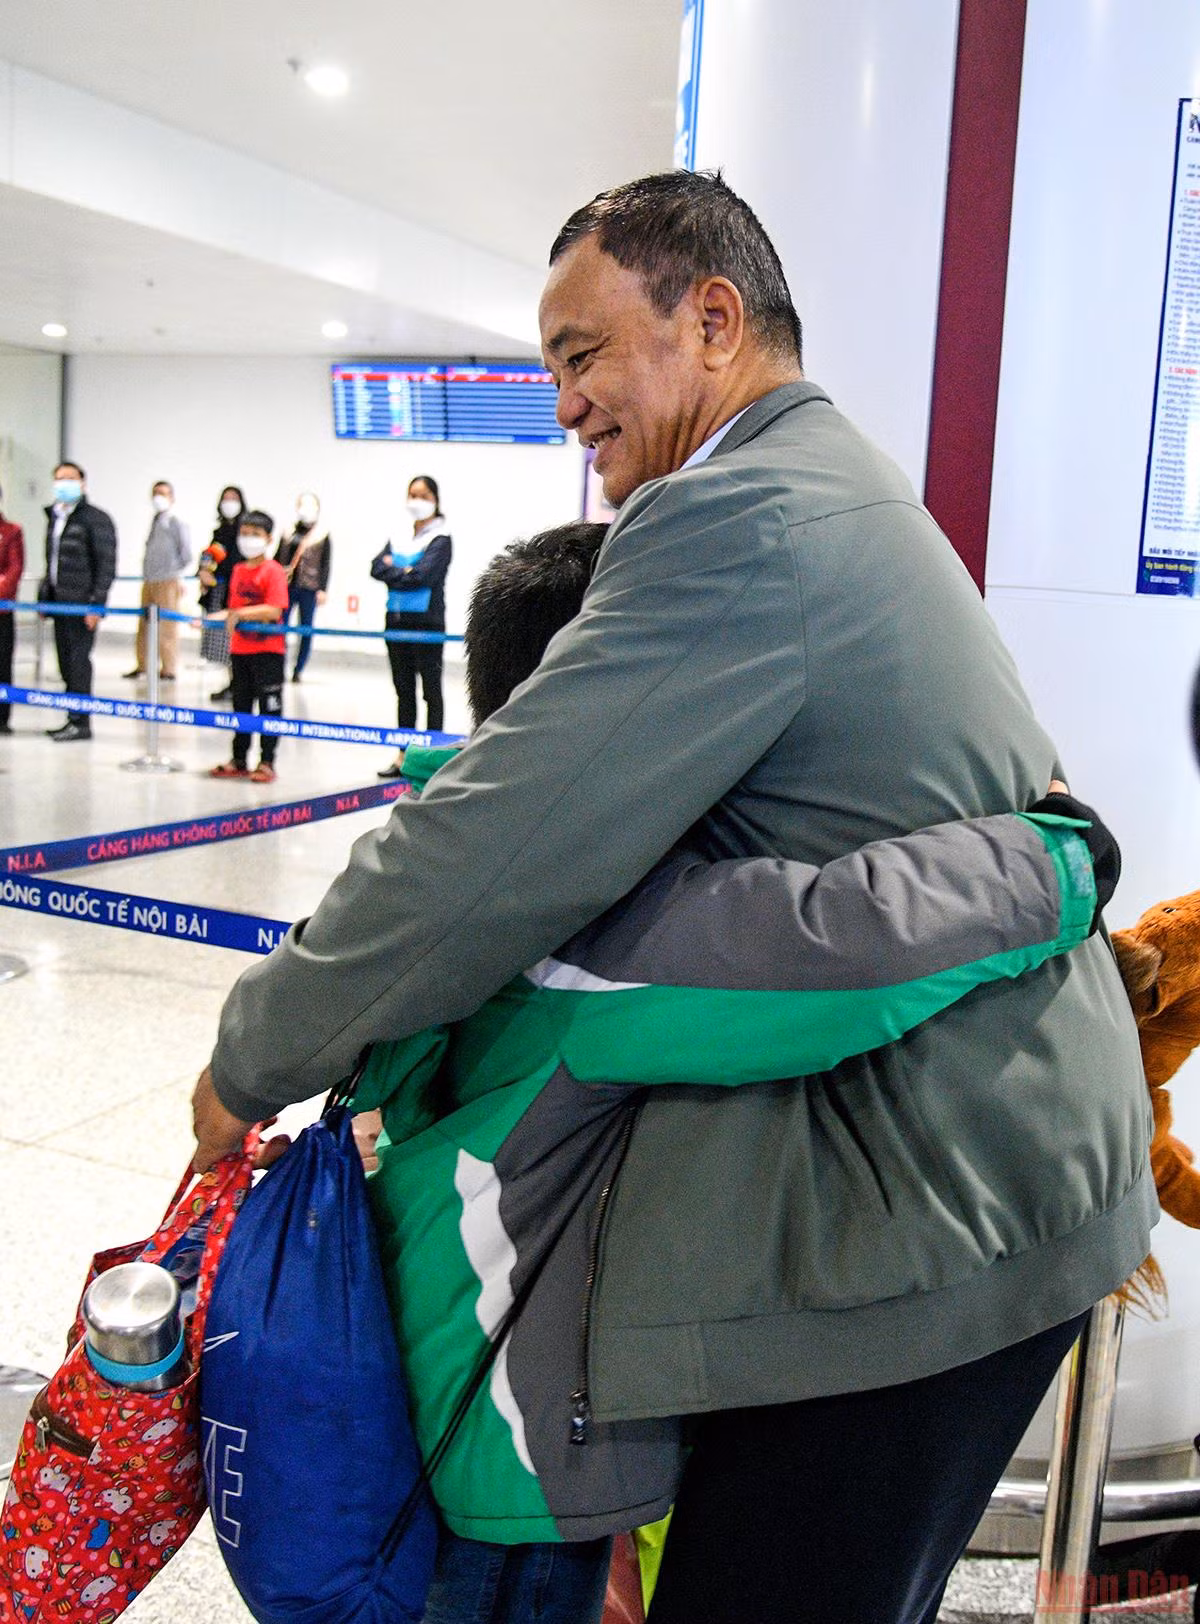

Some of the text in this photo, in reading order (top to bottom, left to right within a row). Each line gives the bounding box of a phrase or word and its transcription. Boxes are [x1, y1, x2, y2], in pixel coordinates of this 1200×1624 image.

[302, 723, 383, 744] INTERNATIONAL
[385, 731, 432, 747] AIRPORT
[7, 851, 46, 873] N.I.A
[172, 823, 217, 845] KHÔNG
[220, 816, 253, 836] QUỐC
[0, 880, 284, 949] ÔNG QUỐC TẾ NỘI BÀI N.I
